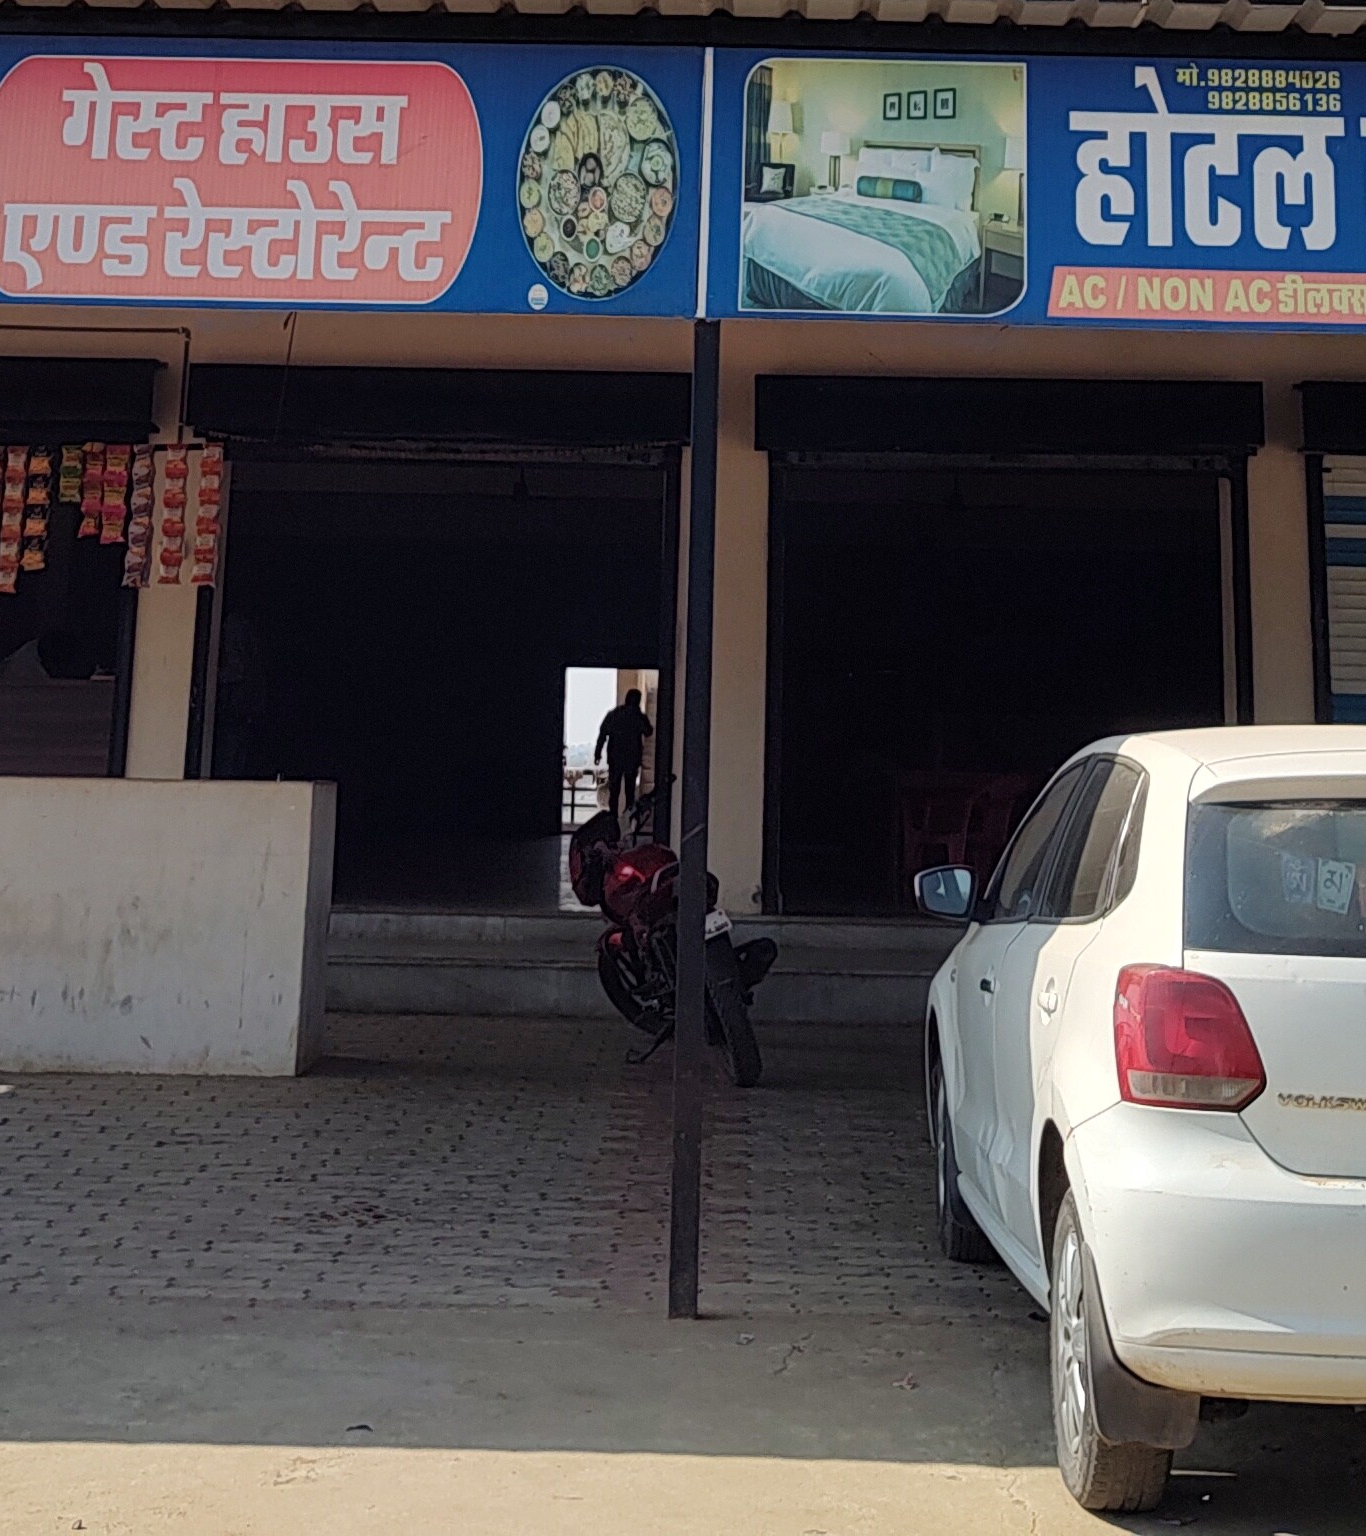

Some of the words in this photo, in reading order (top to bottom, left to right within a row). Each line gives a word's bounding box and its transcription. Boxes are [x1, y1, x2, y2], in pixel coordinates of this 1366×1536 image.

[1176, 63, 1341, 89] मो.9828884026
[1208, 92, 1342, 112] 9828856136
[63, 62, 212, 160] गेस्ट
[219, 93, 409, 166] हाउस
[1068, 65, 1346, 252] होटल
[3, 203, 158, 290] एण्ड
[163, 178, 452, 283] रेस्टोरेन्ट
[1058, 275, 1107, 309] AC
[1137, 278, 1214, 312] NON
[1224, 280, 1272, 313] AC
